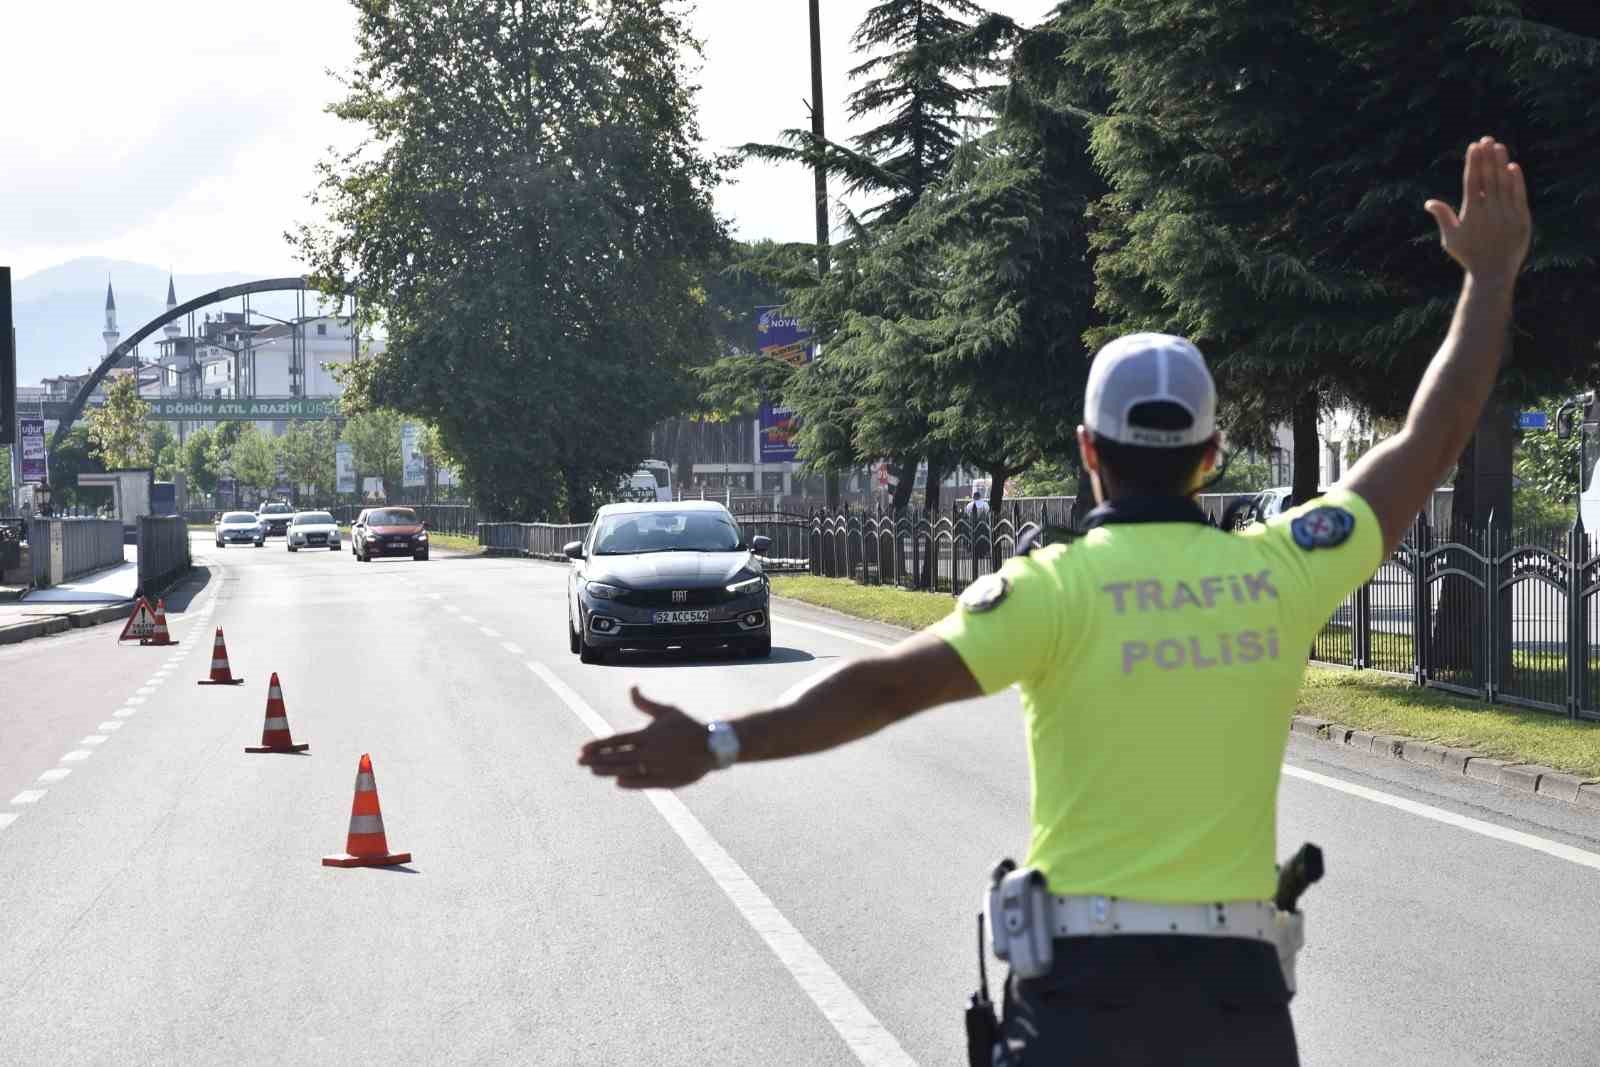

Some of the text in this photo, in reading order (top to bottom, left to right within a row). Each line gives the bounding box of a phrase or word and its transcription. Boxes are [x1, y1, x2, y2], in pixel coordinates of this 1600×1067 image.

[165, 402, 213, 414] DÖNÜM
[217, 404, 246, 414] ATIL
[251, 401, 303, 414] ARAZİYİ
[672, 590, 688, 601] FIAT
[656, 611, 670, 623] 52
[690, 610, 708, 622] 542
